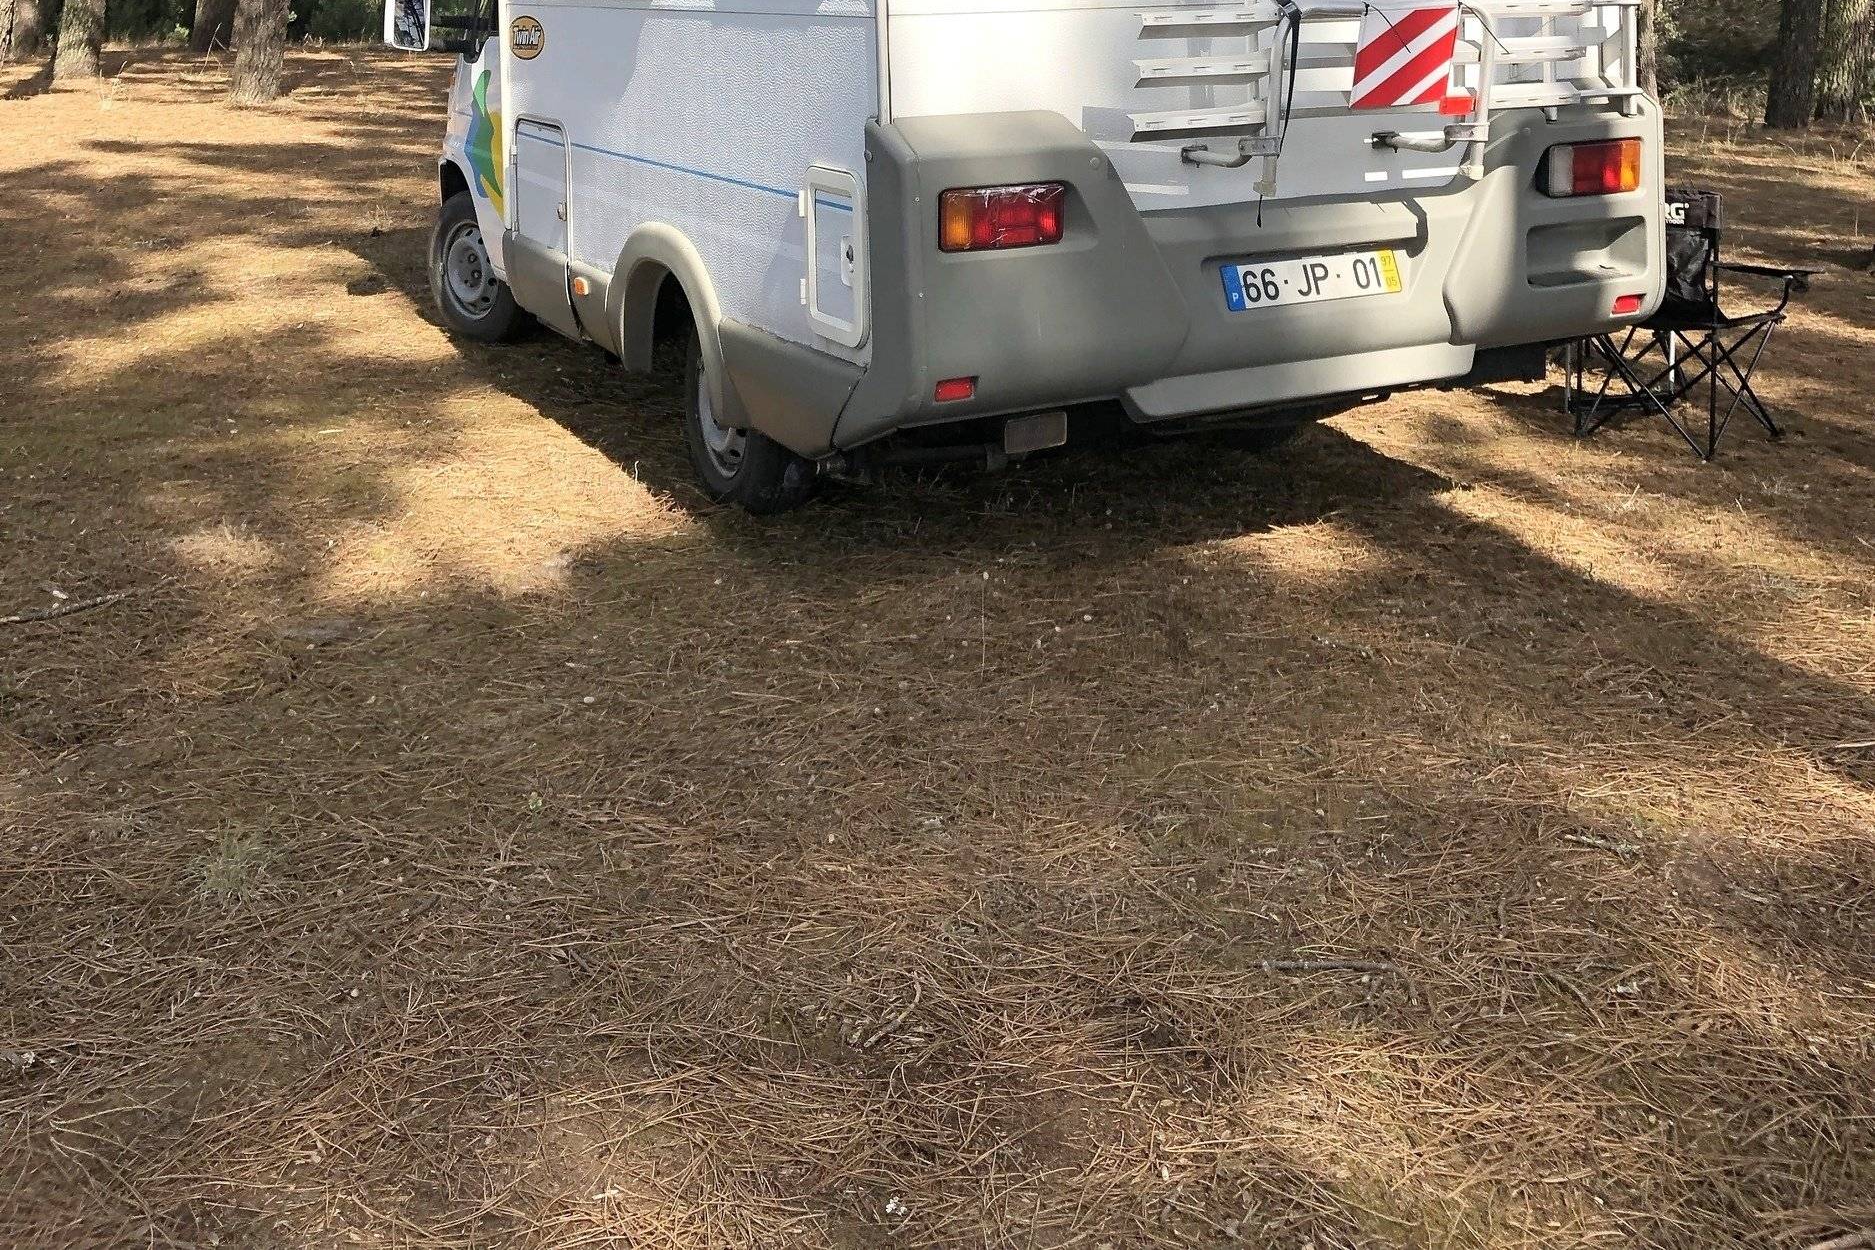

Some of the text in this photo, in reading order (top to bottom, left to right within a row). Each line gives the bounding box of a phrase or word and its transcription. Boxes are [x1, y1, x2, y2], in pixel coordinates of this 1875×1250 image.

[513, 25, 541, 46] Twin Air
[1380, 255, 1393, 267] 97
[1385, 275, 1398, 287] 05
[1232, 292, 1239, 303] P
